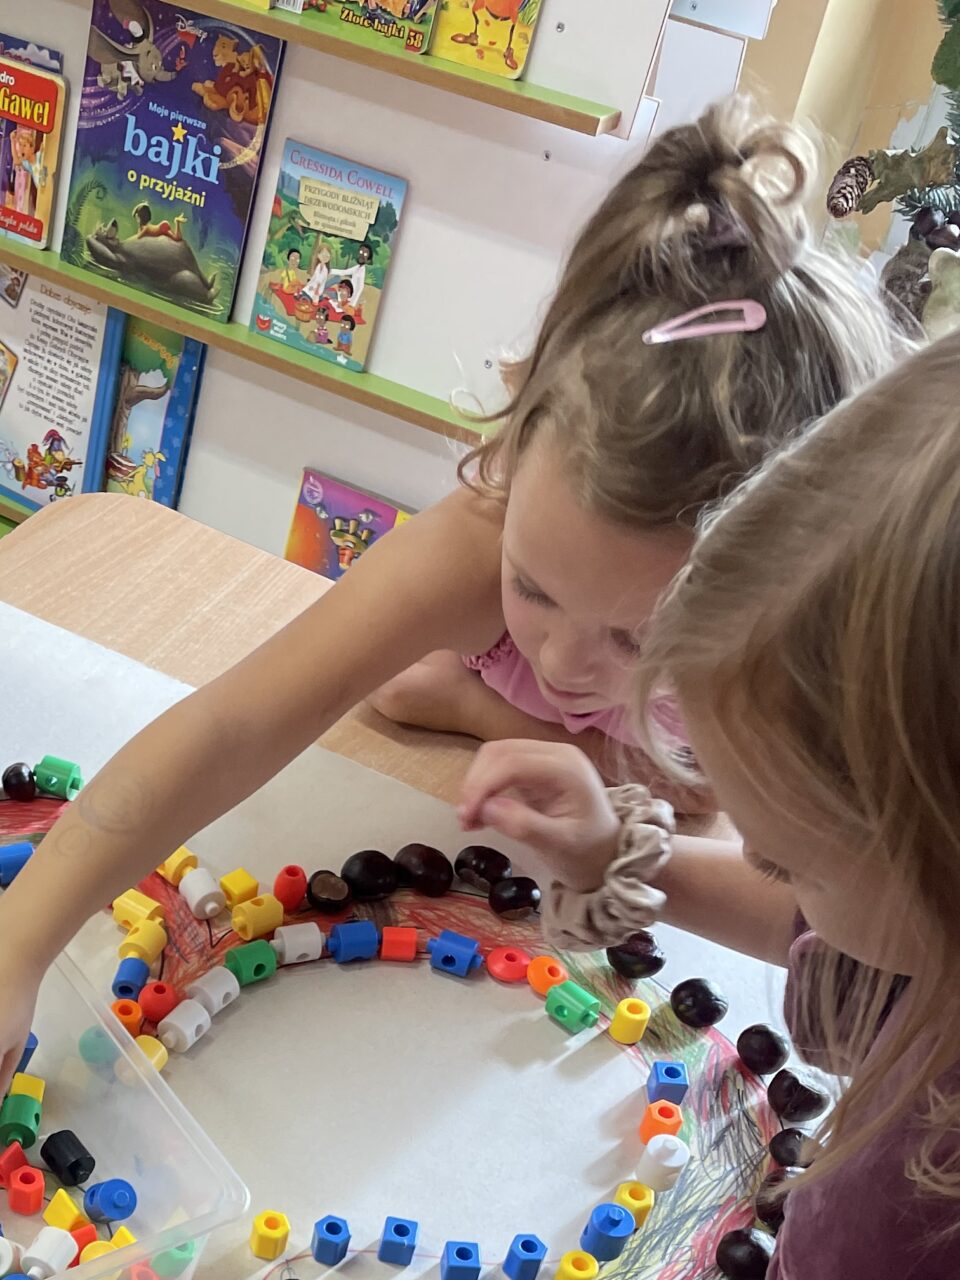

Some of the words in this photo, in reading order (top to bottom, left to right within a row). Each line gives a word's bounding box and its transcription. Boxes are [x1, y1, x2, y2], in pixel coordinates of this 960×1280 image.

[374, 19, 405, 38] bajki
[406, 31, 423, 48] 58
[149, 101, 168, 117] Moje
[170, 111, 207, 129] pierwsze
[124, 113, 222, 184] bajki
[127, 170, 137, 182] o
[140, 174, 206, 207] przyjaźni
[290, 150, 343, 182] CRESSIDA
[347, 170, 394, 199] COWELL
